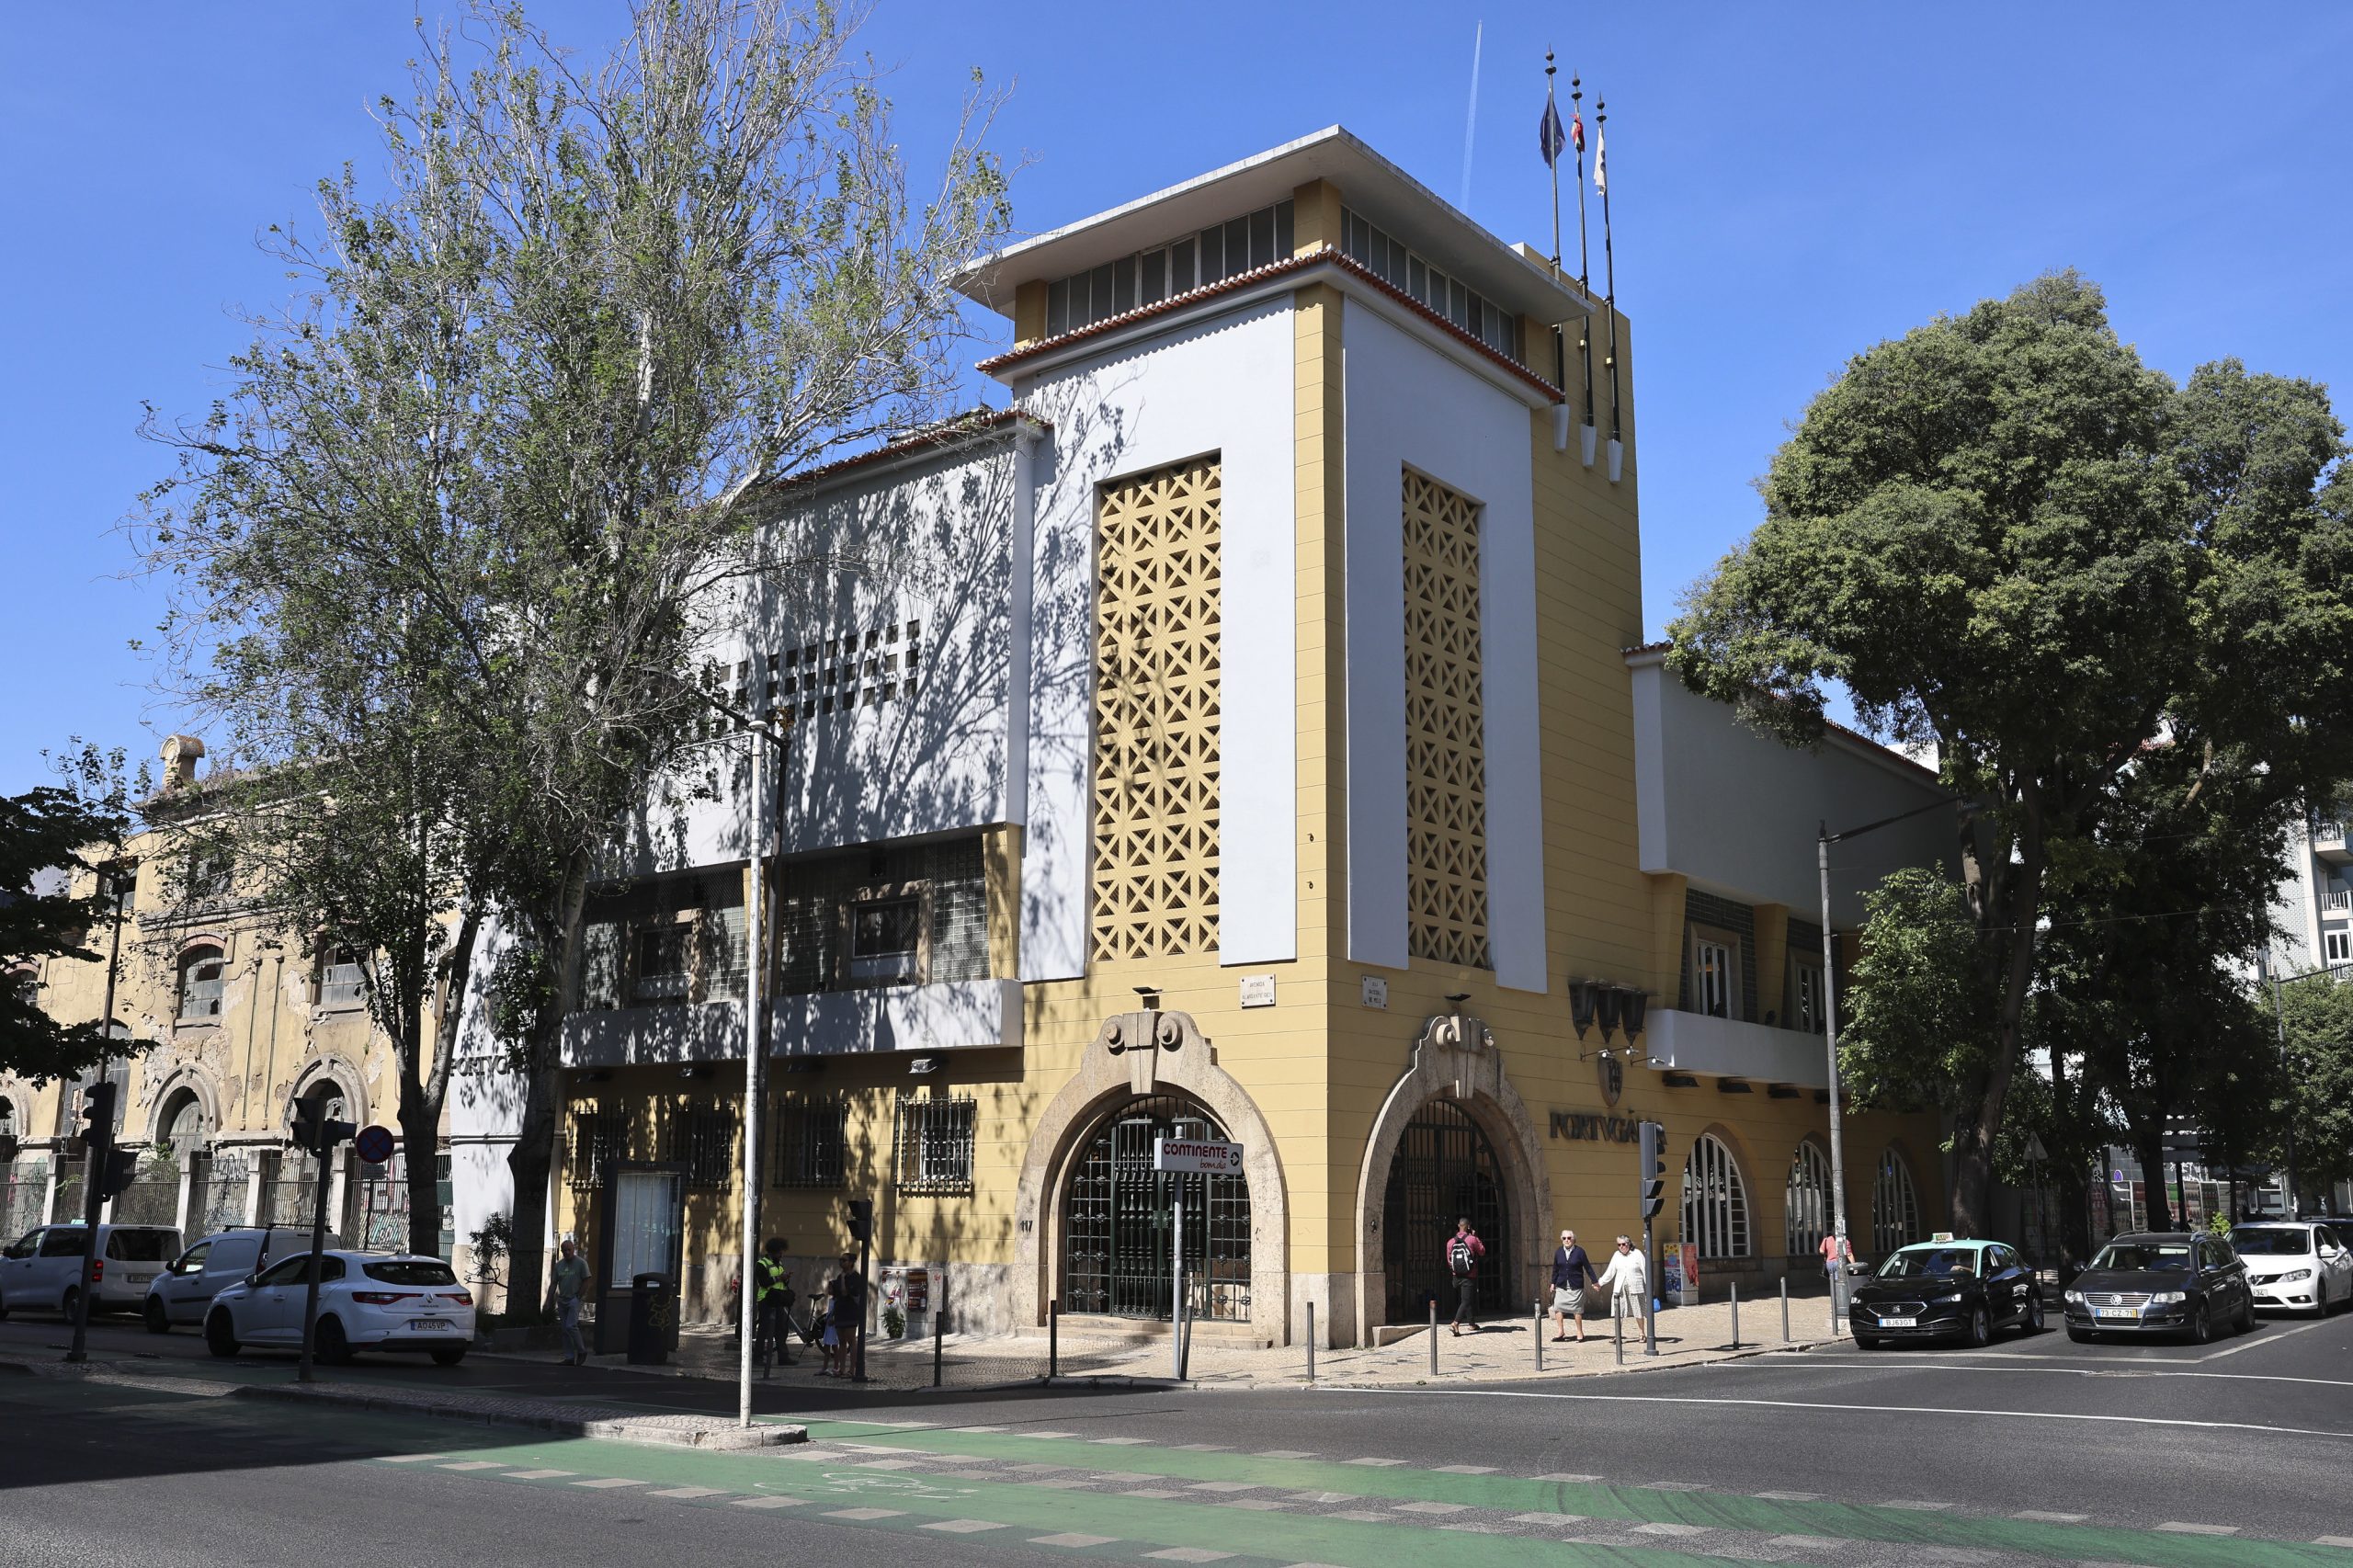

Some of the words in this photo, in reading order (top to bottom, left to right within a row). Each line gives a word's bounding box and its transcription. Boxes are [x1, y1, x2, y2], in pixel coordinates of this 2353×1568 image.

[1164, 1143, 1227, 1158] CONTINENTE
[1200, 1158, 1216, 1169] bom
[1216, 1159, 1227, 1170] dia
[1020, 1220, 1033, 1233] 117
